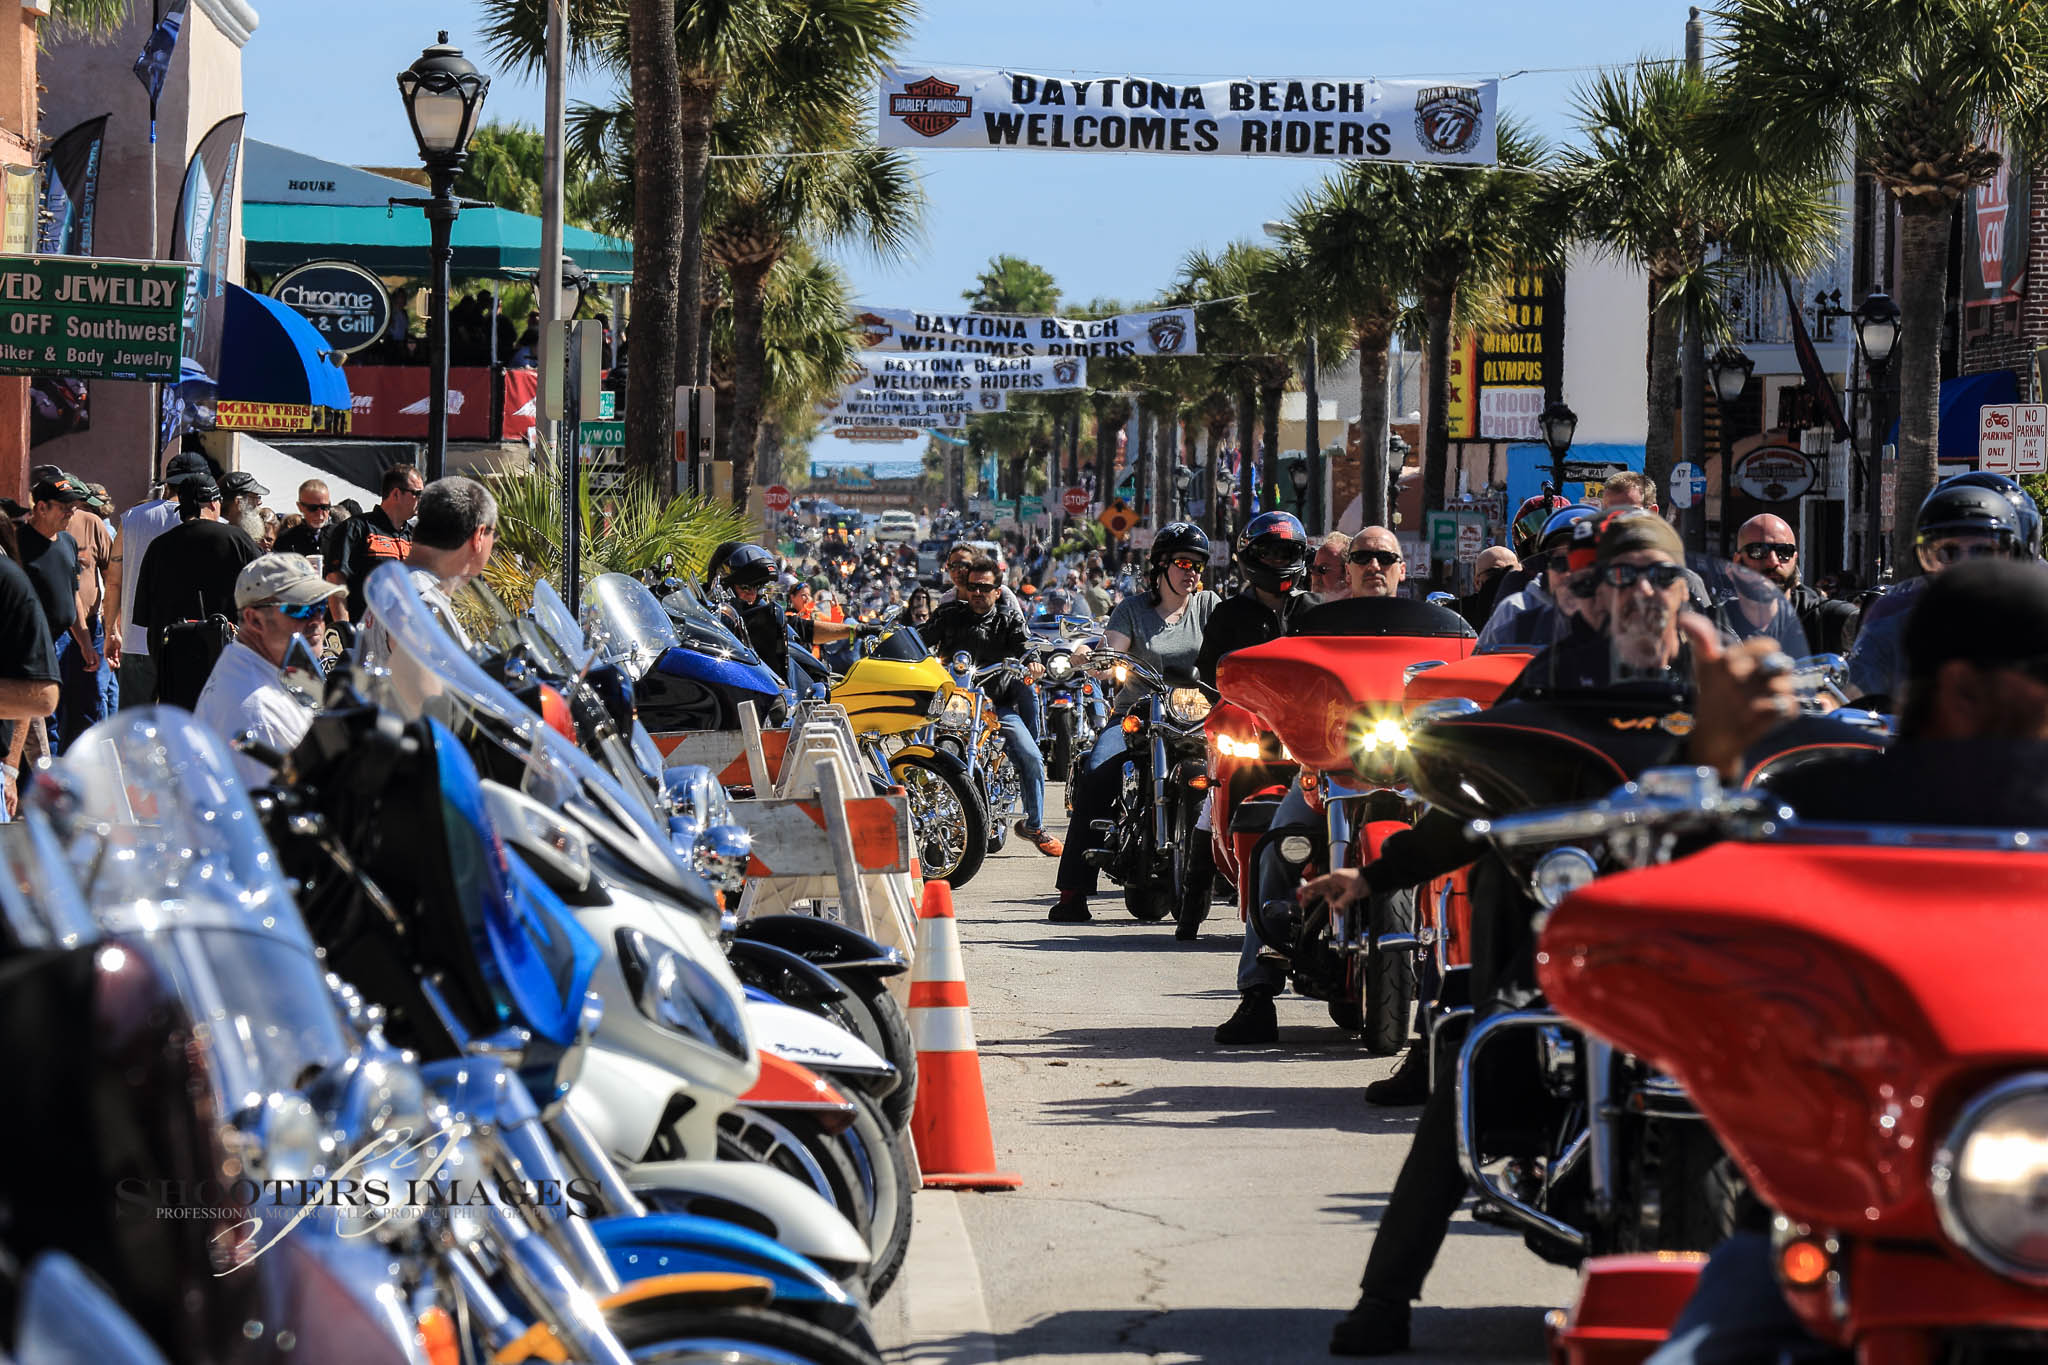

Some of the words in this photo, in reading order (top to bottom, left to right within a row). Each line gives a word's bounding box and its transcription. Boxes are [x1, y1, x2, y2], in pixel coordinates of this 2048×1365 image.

[911, 86, 954, 96] MOTOR
[1011, 75, 1206, 110] DAYTONA
[1229, 82, 1365, 113] BEACH
[894, 98, 968, 114] HARLEY-DAVIDSON
[908, 115, 953, 132] CYCLES
[984, 112, 1219, 151] WELCOMES
[1240, 119, 1392, 156] RIDERS
[288, 180, 336, 192] HOUSE
[55, 275, 177, 307] JEWELRY
[281, 286, 373, 310] Chrome
[10, 312, 52, 335] OFF
[66, 316, 176, 342] Southwest
[318, 317, 331, 332] &
[338, 317, 374, 333] Grill
[915, 314, 1027, 339] DAYTONA
[1041, 319, 1118, 340] BEACH
[900, 335, 1036, 357] WELCOMES
[1483, 333, 1543, 354] MINOLTA
[44, 346, 56, 361] &
[67, 347, 104, 366] Body
[114, 350, 173, 369] Jewelry
[885, 359, 964, 372] DAYTONA
[1483, 360, 1543, 382] OLYMPUS
[873, 374, 972, 390] WELCOMES
[980, 373, 1044, 390] RIDERS
[218, 402, 272, 415] OCKET
[274, 404, 310, 417] TEES
[846, 402, 919, 415] WELCOMES
[926, 402, 973, 415] RIDERS
[1496, 392, 1542, 413] HOUR
[216, 415, 304, 428] AVAILABLE!
[2025, 410, 2037, 422] NO
[1483, 416, 1542, 437] PHOTO
[2017, 425, 2045, 438] PARKING
[1982, 431, 2013, 441] PARKING
[2024, 439, 2036, 447] ANY
[1987, 447, 2006, 457] ONLY
[2023, 450, 2038, 459] TIME
[765, 494, 789, 505] STOP
[1065, 495, 1089, 505] STOP
